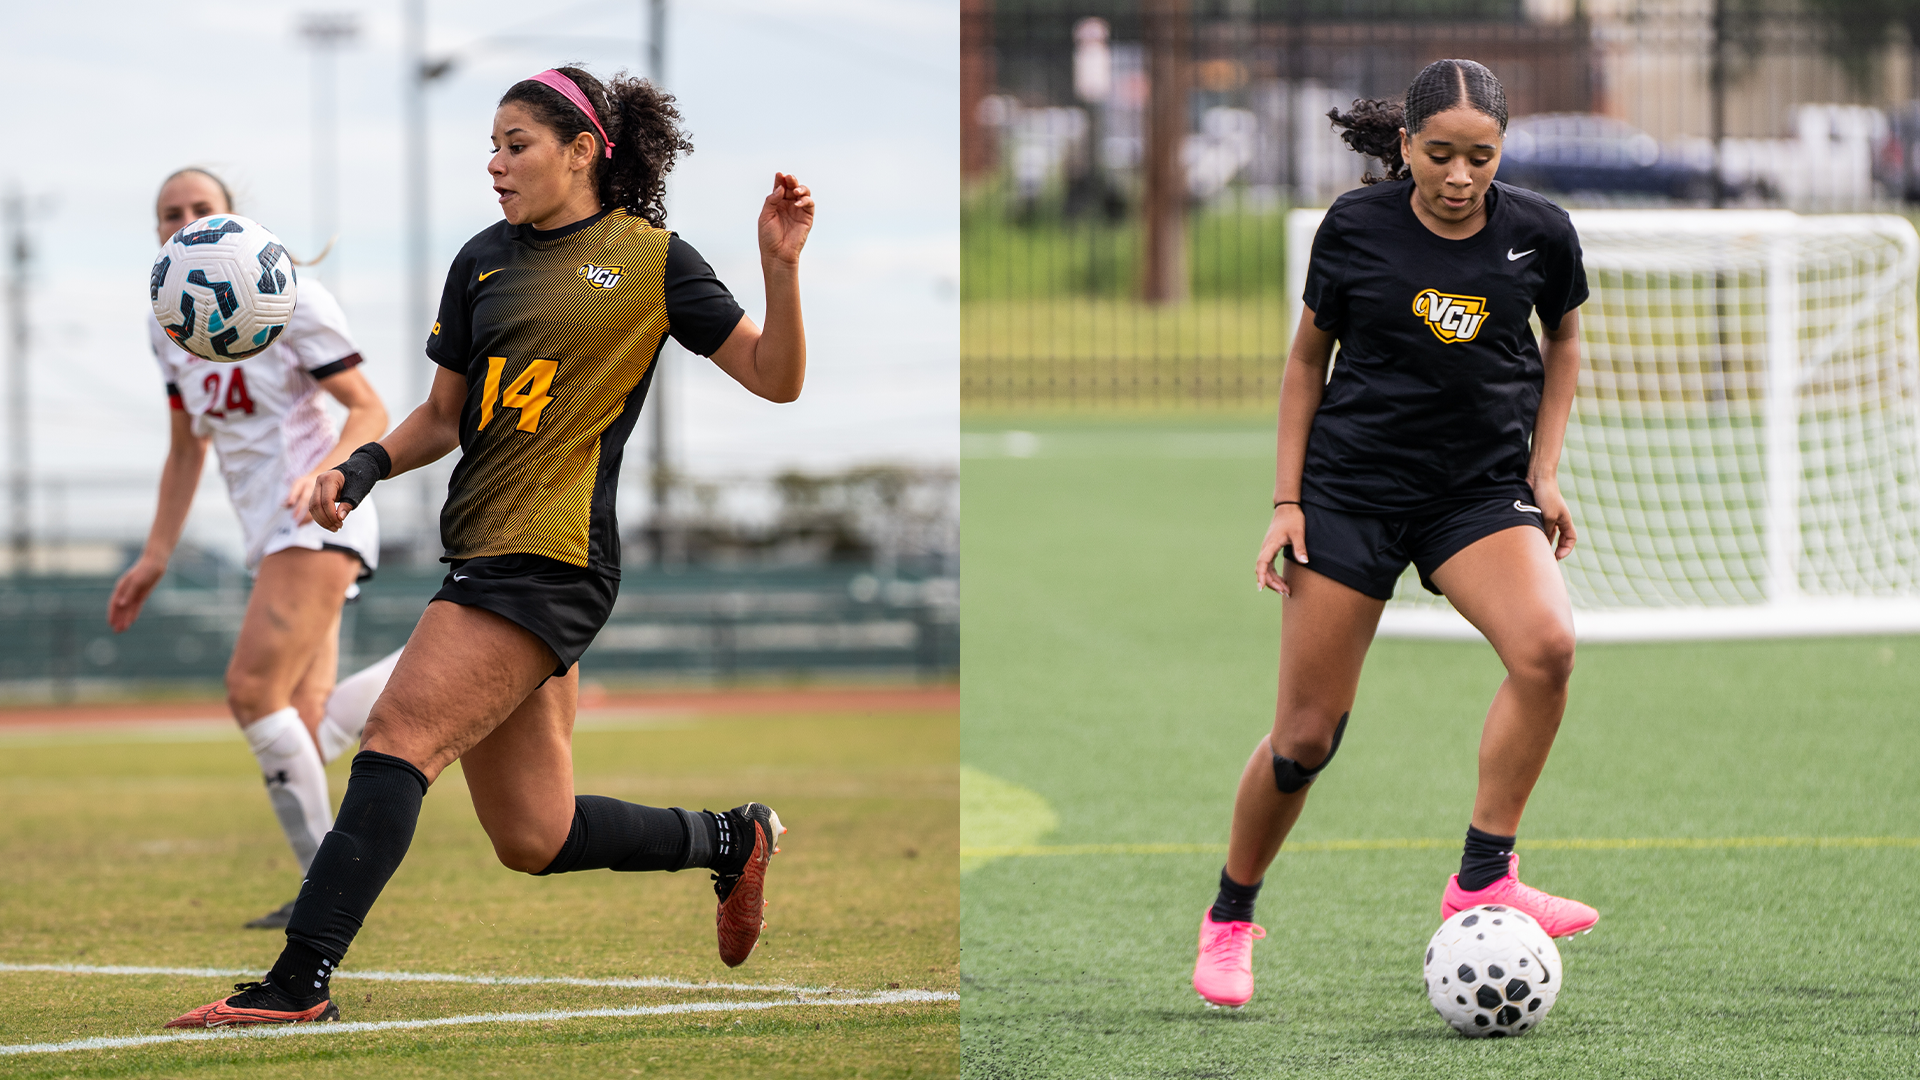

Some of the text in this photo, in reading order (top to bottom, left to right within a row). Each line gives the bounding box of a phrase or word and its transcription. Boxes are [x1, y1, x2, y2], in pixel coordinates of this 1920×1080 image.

[584, 263, 622, 289] VCU
[1423, 291, 1483, 339] VCU
[202, 365, 255, 419] 24
[477, 356, 560, 434] 14
